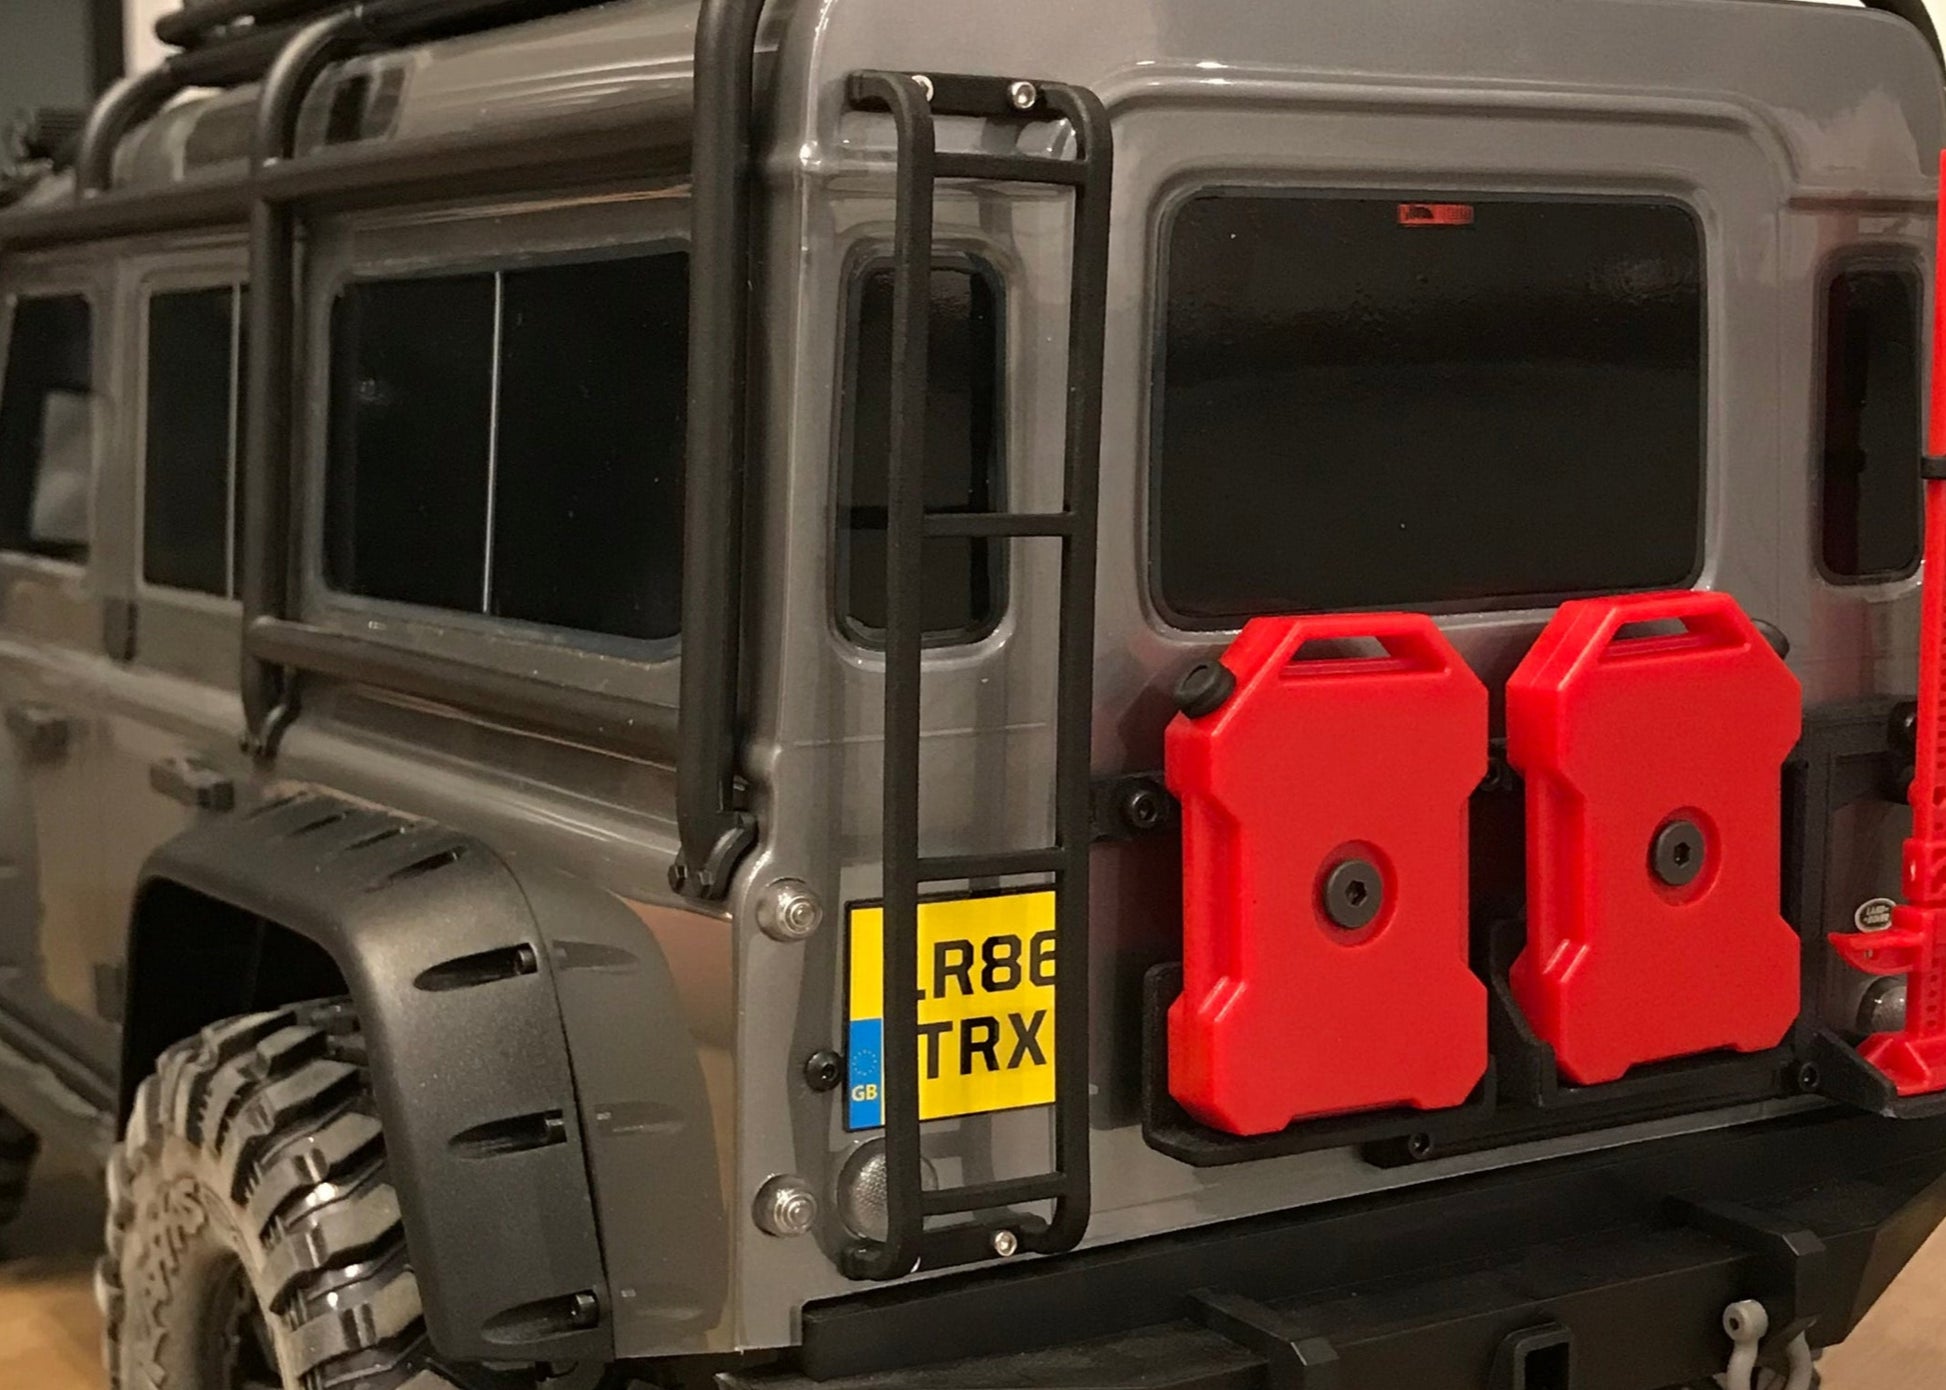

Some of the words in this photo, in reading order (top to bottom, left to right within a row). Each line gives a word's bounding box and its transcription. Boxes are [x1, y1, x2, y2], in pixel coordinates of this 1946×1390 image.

[917, 930, 1056, 1000] R86
[917, 1009, 1047, 1080] TRX
[851, 1084, 878, 1101] GB
